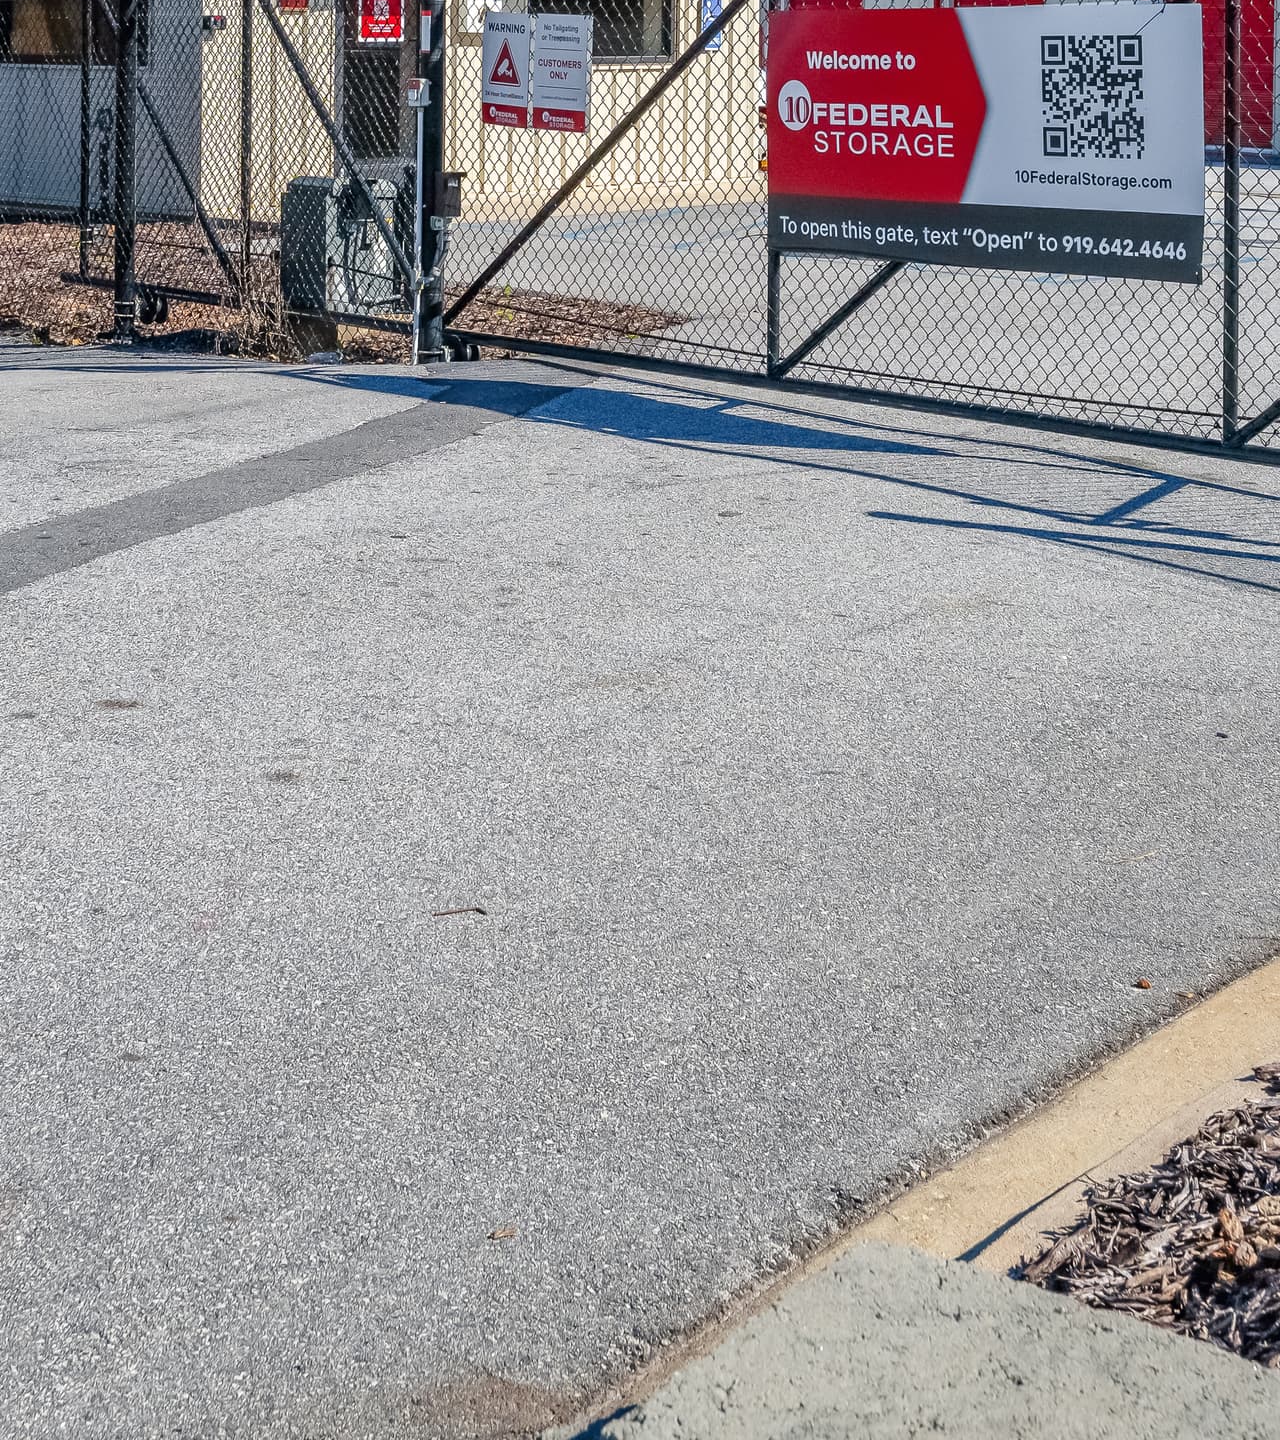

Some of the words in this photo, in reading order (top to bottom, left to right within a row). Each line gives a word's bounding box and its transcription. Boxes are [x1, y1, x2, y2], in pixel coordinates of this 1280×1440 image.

[488, 22, 526, 34] WARNING
[552, 24, 579, 34] Tailgating
[537, 58, 582, 70] CUSTOMERS
[806, 50, 892, 71] Welcome
[895, 50, 916, 71] to
[549, 70, 568, 80] ONLY
[495, 111, 518, 119] FEDERAL
[784, 96, 810, 124] 10
[812, 102, 955, 129] FEDERAL
[549, 116, 575, 124] FEDERAL
[814, 130, 955, 158] STORAGE
[1014, 169, 1172, 190] 10FederalStorage.com
[779, 215, 797, 234] To
[801, 220, 838, 239] open
[841, 219, 872, 240] this
[876, 225, 918, 246] gate,
[922, 225, 959, 246] text
[963, 228, 1033, 252] “Open”
[1037, 233, 1058, 252] to
[1062, 235, 1187, 261] 919.642.4646
